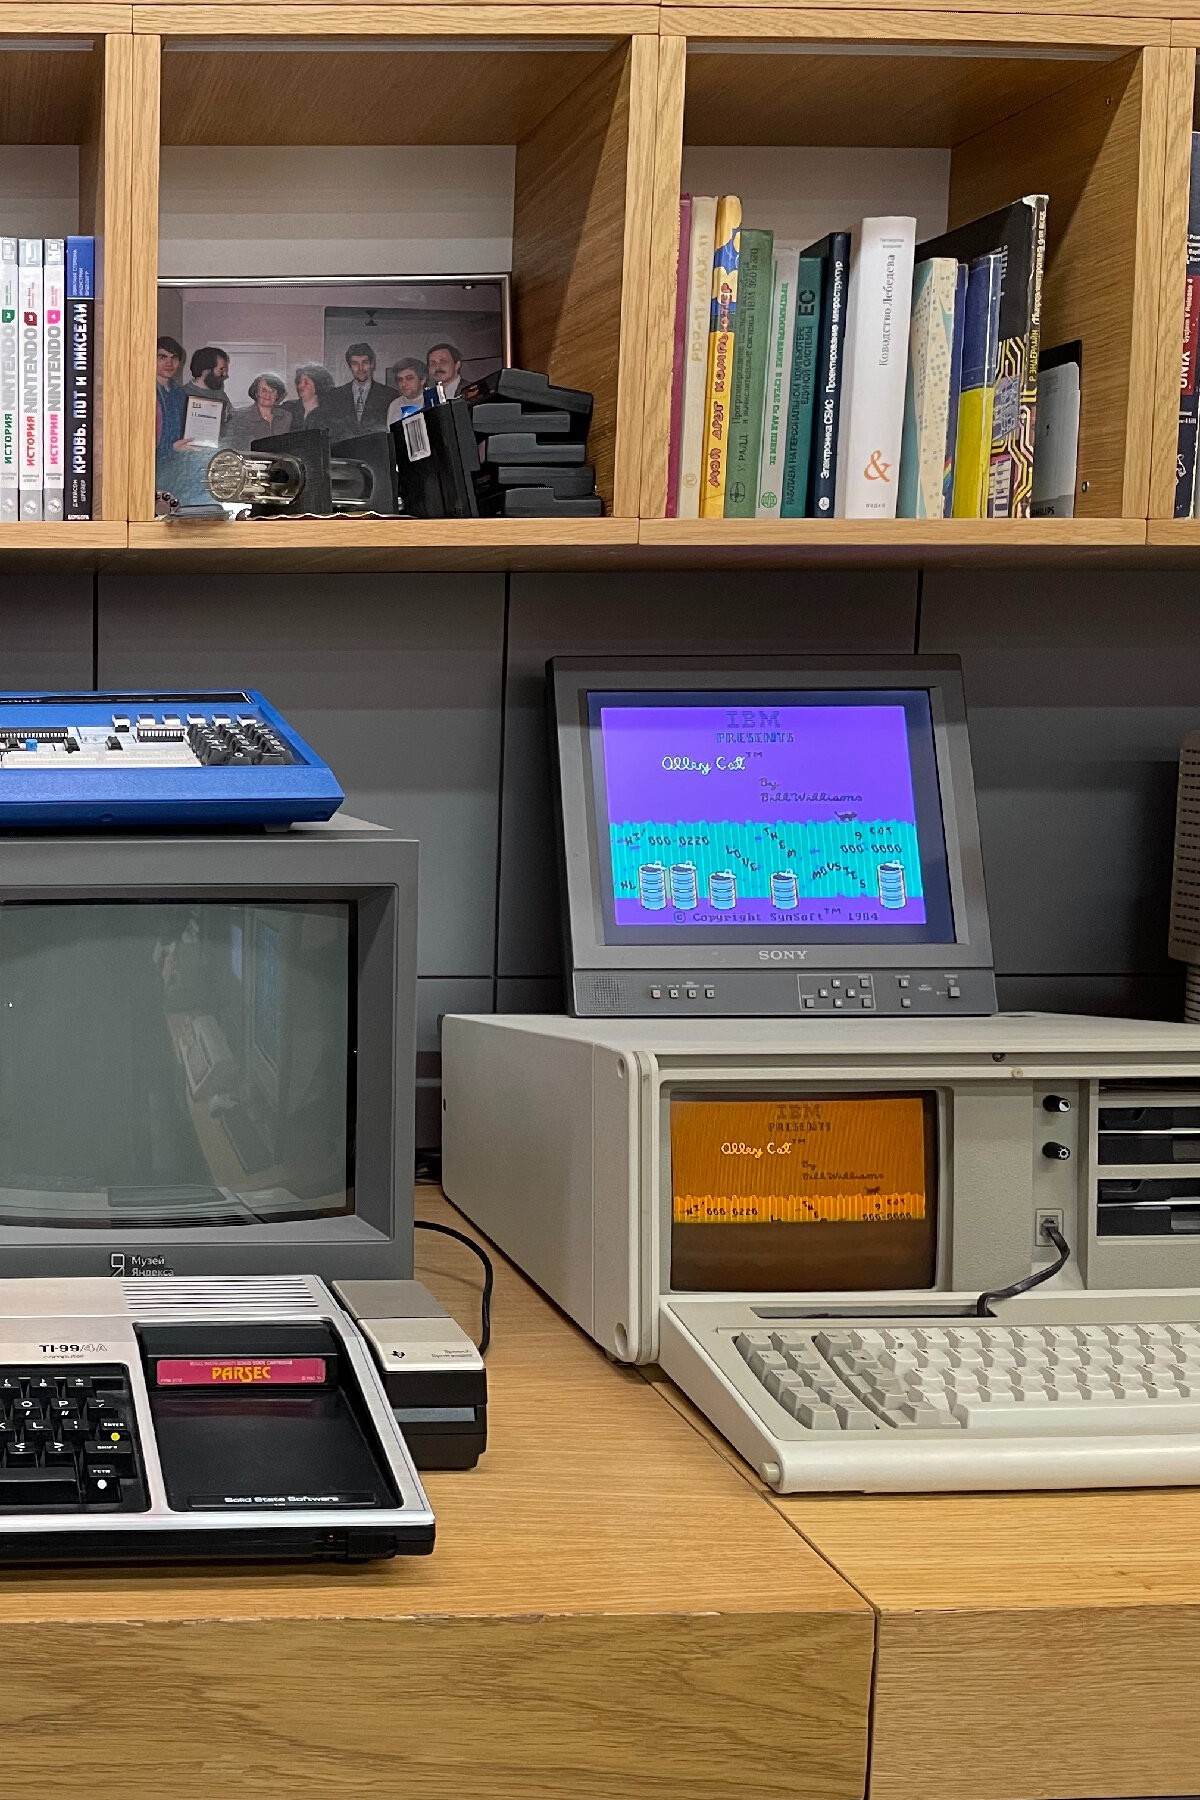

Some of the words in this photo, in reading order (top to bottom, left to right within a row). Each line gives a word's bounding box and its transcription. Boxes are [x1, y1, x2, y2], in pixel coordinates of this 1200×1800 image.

[832, 260, 843, 322] микроструктур
[882, 254, 896, 306] Лебедева
[799, 289, 816, 317] ЕС
[73, 304, 87, 370] ПИКСЕЛИ
[714, 283, 732, 392] КОМПЬЮТЕР
[775, 282, 789, 368] ПРОГРАММИРОВАНИЕ
[878, 308, 892, 367] Ководство
[794, 326, 805, 381] КОМПЬЮТЕРЕ
[803, 326, 813, 367] СИСТЕМЫ
[826, 324, 839, 393] Проектирование
[1029, 329, 1039, 375] ЭНДЕРЛАЙН
[1, 325, 16, 411] NINTENDO
[24, 328, 38, 414] NINTENDO
[47, 326, 61, 412] NINTENDO
[801, 368, 811, 405] ЕДИНОЙ
[1180, 351, 1190, 389] UNIX
[73, 391, 87, 419] ПОТ
[711, 400, 724, 440] ДРУГ
[790, 383, 801, 451] ПЕРСОНАЛЬНОМ
[823, 399, 834, 425] СБИС
[4, 413, 13, 464] ИСТОРИЯ
[27, 416, 35, 466] ИСТОРИЯ
[50, 414, 59, 465] ИСТОРИЯ
[789, 451, 798, 464] НА
[821, 424, 833, 479] Электроника
[708, 448, 721, 488] МОЙ
[786, 465, 796, 506] РАБОТАЕМ
[716, 732, 795, 743] PRESENTS
[726, 710, 781, 728] IBM
[661, 756, 712, 775] Alley
[715, 756, 746, 771] Cat
[760, 778, 780, 790] By
[764, 826, 797, 859] THEM
[692, 912, 762, 922] Copyright
[769, 912, 823, 922] SynSoft
[848, 912, 878, 921] 1984
[758, 950, 808, 960] SONY
[768, 1122, 831, 1132] PRESENTS
[776, 1104, 822, 1120] IBM
[720, 1143, 763, 1159] Alley
[767, 1142, 793, 1155] Cat
[131, 1255, 165, 1267] Музей
[131, 1267, 174, 1277] Яндекса
[39, 1344, 108, 1353] TI-99/4A
[212, 1367, 271, 1383] PARSEC
